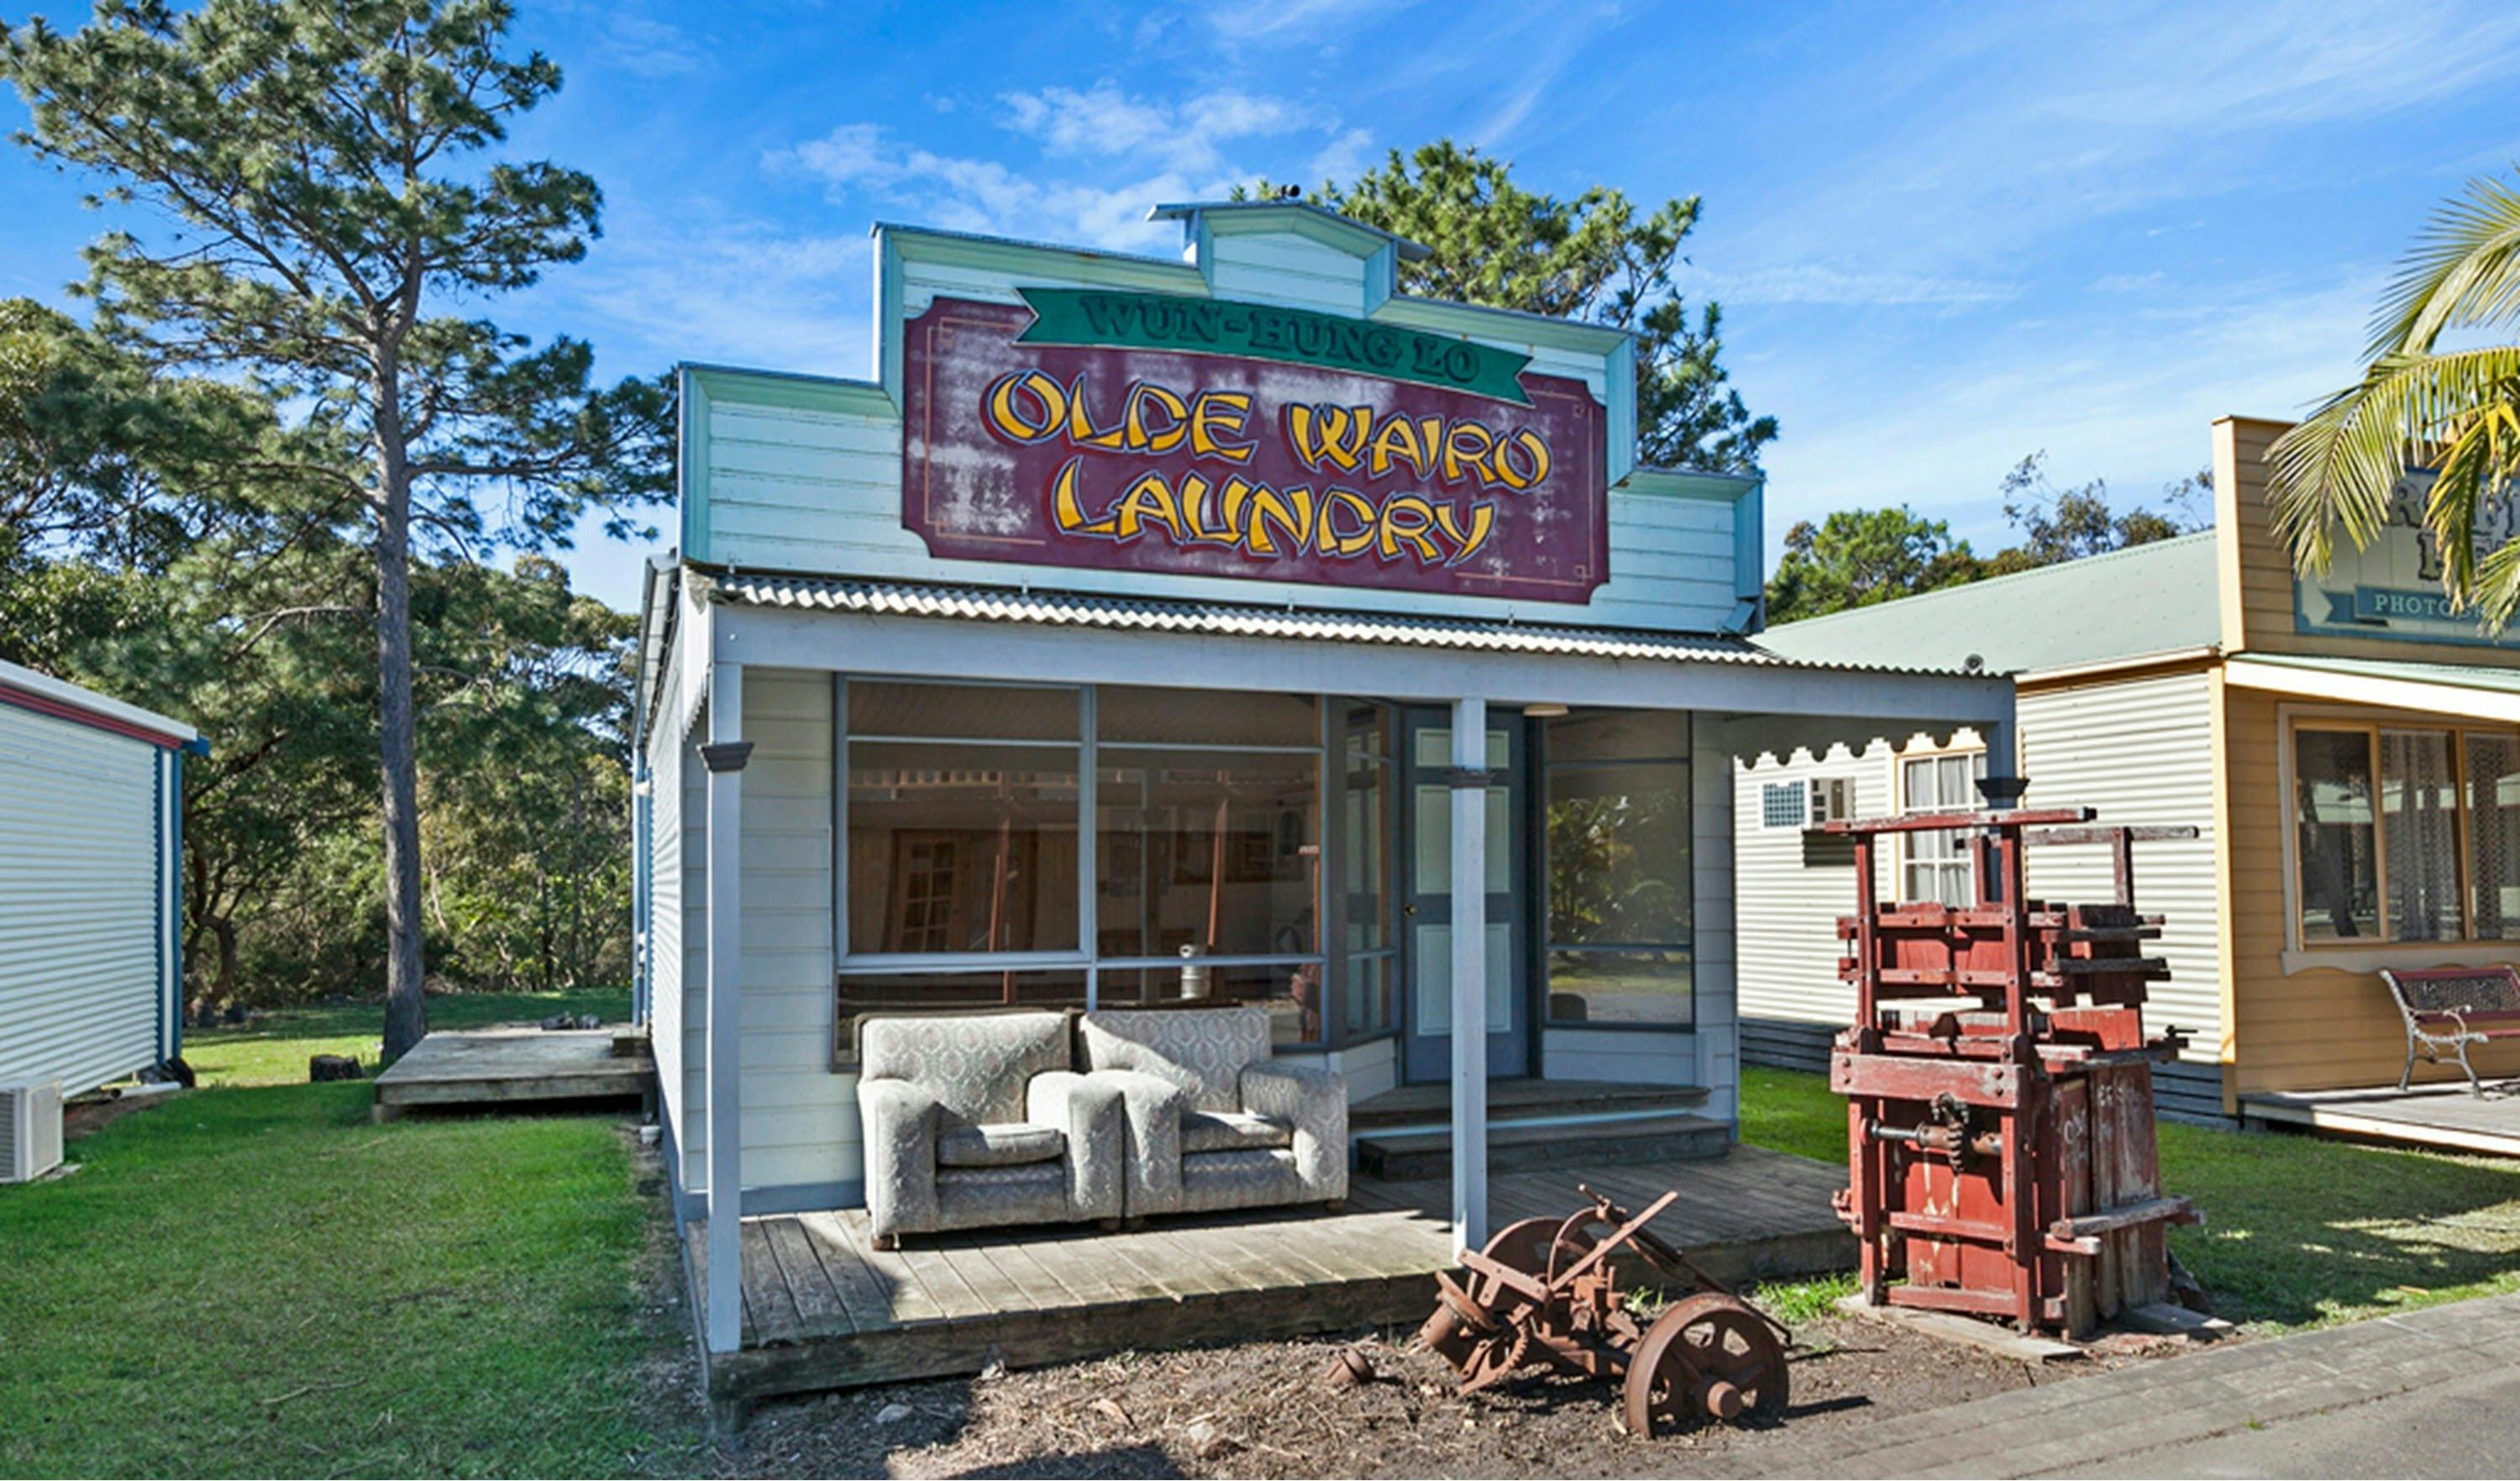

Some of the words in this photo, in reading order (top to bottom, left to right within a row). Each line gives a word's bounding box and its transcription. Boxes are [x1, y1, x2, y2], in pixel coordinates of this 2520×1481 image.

[1080, 294, 1401, 368] WUN-HUNG
[1411, 338, 1481, 383] LO
[984, 367, 1258, 463] OLDE
[1288, 400, 1552, 492] WAIRO
[1053, 456, 1497, 570] LAUNDRY
